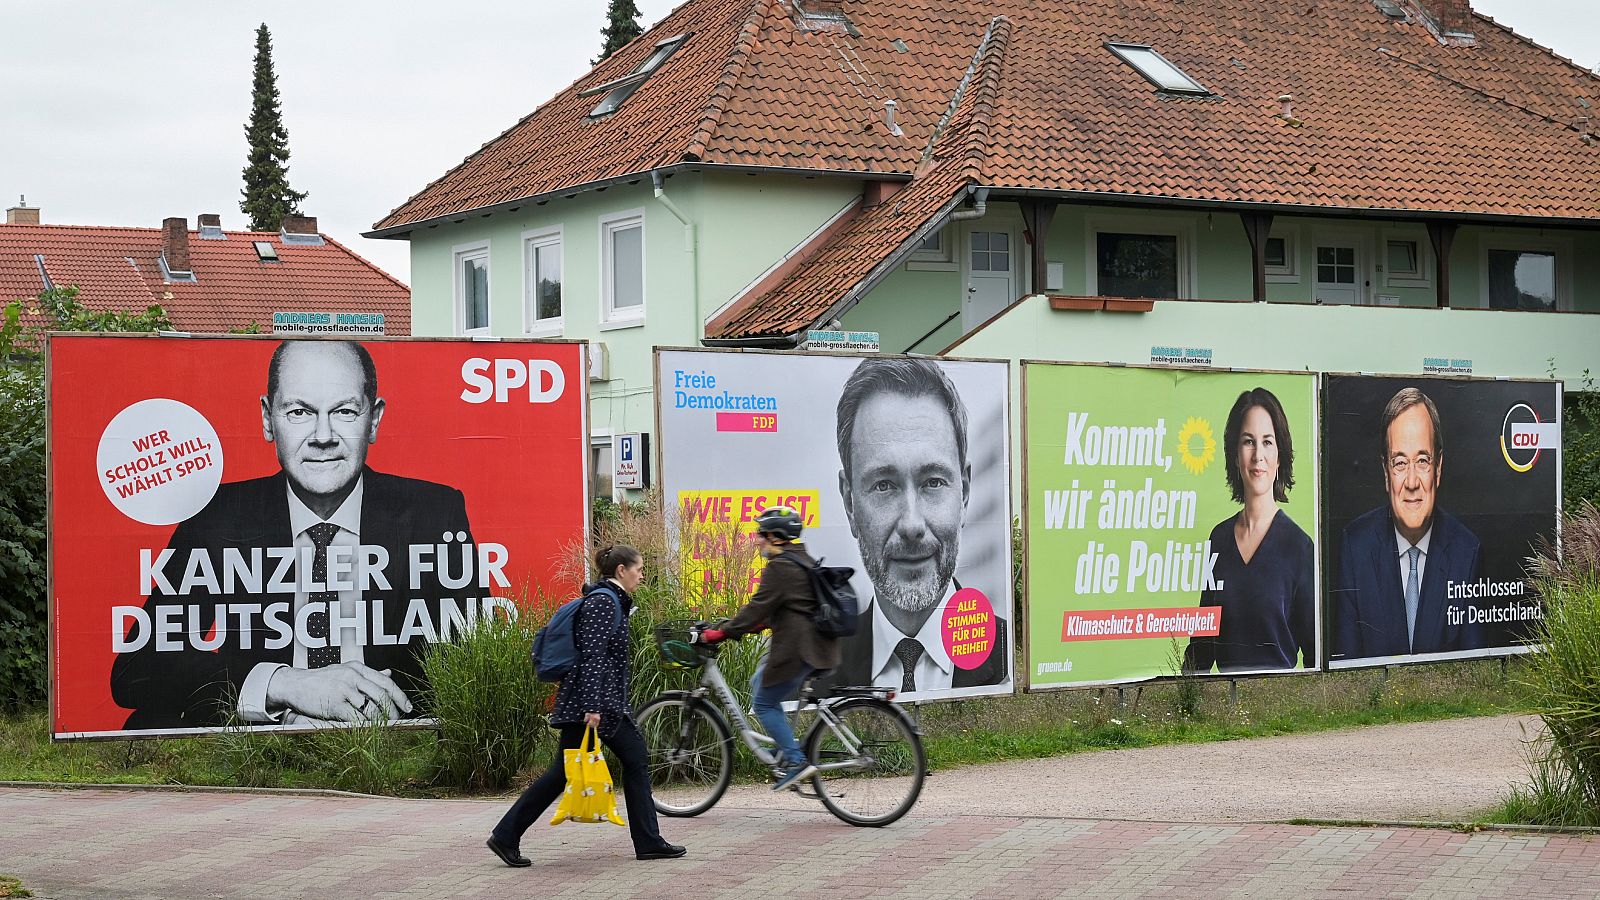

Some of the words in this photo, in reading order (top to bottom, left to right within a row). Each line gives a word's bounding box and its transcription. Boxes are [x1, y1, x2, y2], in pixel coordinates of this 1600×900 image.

[273, 313, 331, 324] ANDREAS
[336, 314, 385, 325] HANSEN
[273, 324, 384, 333] mobile-grossflaechen.de
[460, 357, 566, 404] SPD
[674, 370, 716, 388] Freie
[674, 391, 778, 410] Demokraten
[752, 416, 775, 429] FDP
[132, 430, 171, 453] WER
[622, 439, 631, 459] P
[1064, 411, 1173, 473] Kommt,
[1513, 433, 1540, 447] CDU
[105, 451, 167, 484] SCHOLZ
[167, 437, 212, 460] WILL,
[116, 467, 173, 499] WÄHLT
[175, 453, 213, 478] SPD!
[684, 496, 733, 524] WIE
[740, 495, 768, 523] ES
[1044, 479, 1093, 530] wir
[1098, 477, 1197, 530] ändern
[139, 545, 393, 597] KANZLER
[408, 531, 512, 591] FÜR
[1074, 540, 1120, 595] die
[1126, 539, 1225, 594] Politik.
[1447, 577, 1524, 599] Entschlossen
[956, 599, 977, 613] ALLE
[1447, 605, 1466, 626] für
[947, 611, 989, 629] STIMMEN
[1066, 614, 1134, 637] Klimaschutz
[1135, 614, 1145, 634] &
[1146, 612, 1217, 636] Gerechtigkeit.
[952, 628, 970, 642] FÜR
[971, 626, 986, 639] DIE
[951, 640, 989, 657] FREIHEIT
[1037, 658, 1073, 676] gruene.de
